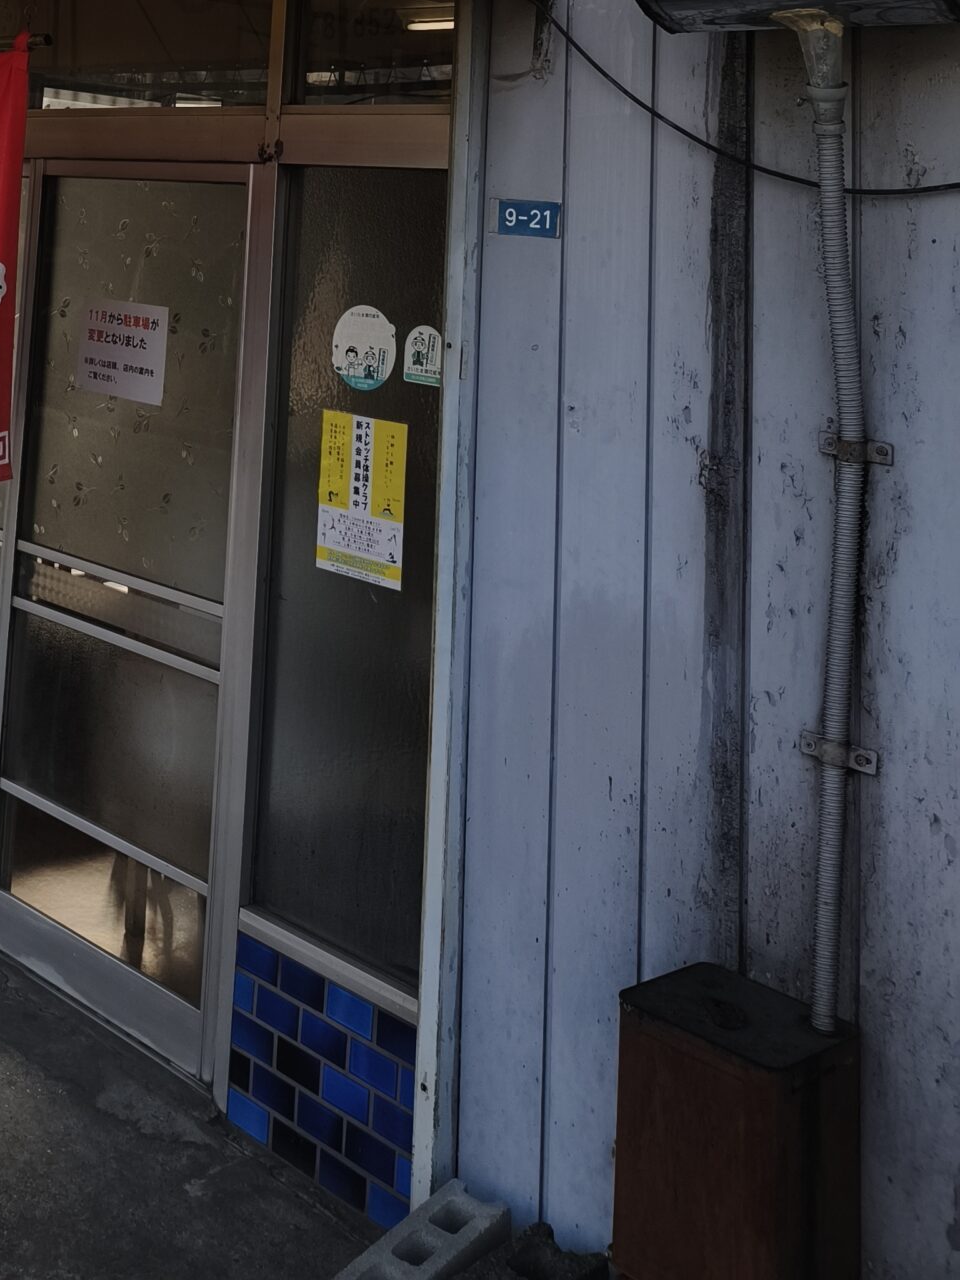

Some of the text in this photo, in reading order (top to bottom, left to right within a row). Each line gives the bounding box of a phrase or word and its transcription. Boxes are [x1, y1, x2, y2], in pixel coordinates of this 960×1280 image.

[505, 207, 551, 229] 9-21
[88, 309, 160, 331] 11月から駐車場が
[87, 328, 147, 350] 変更となりました
